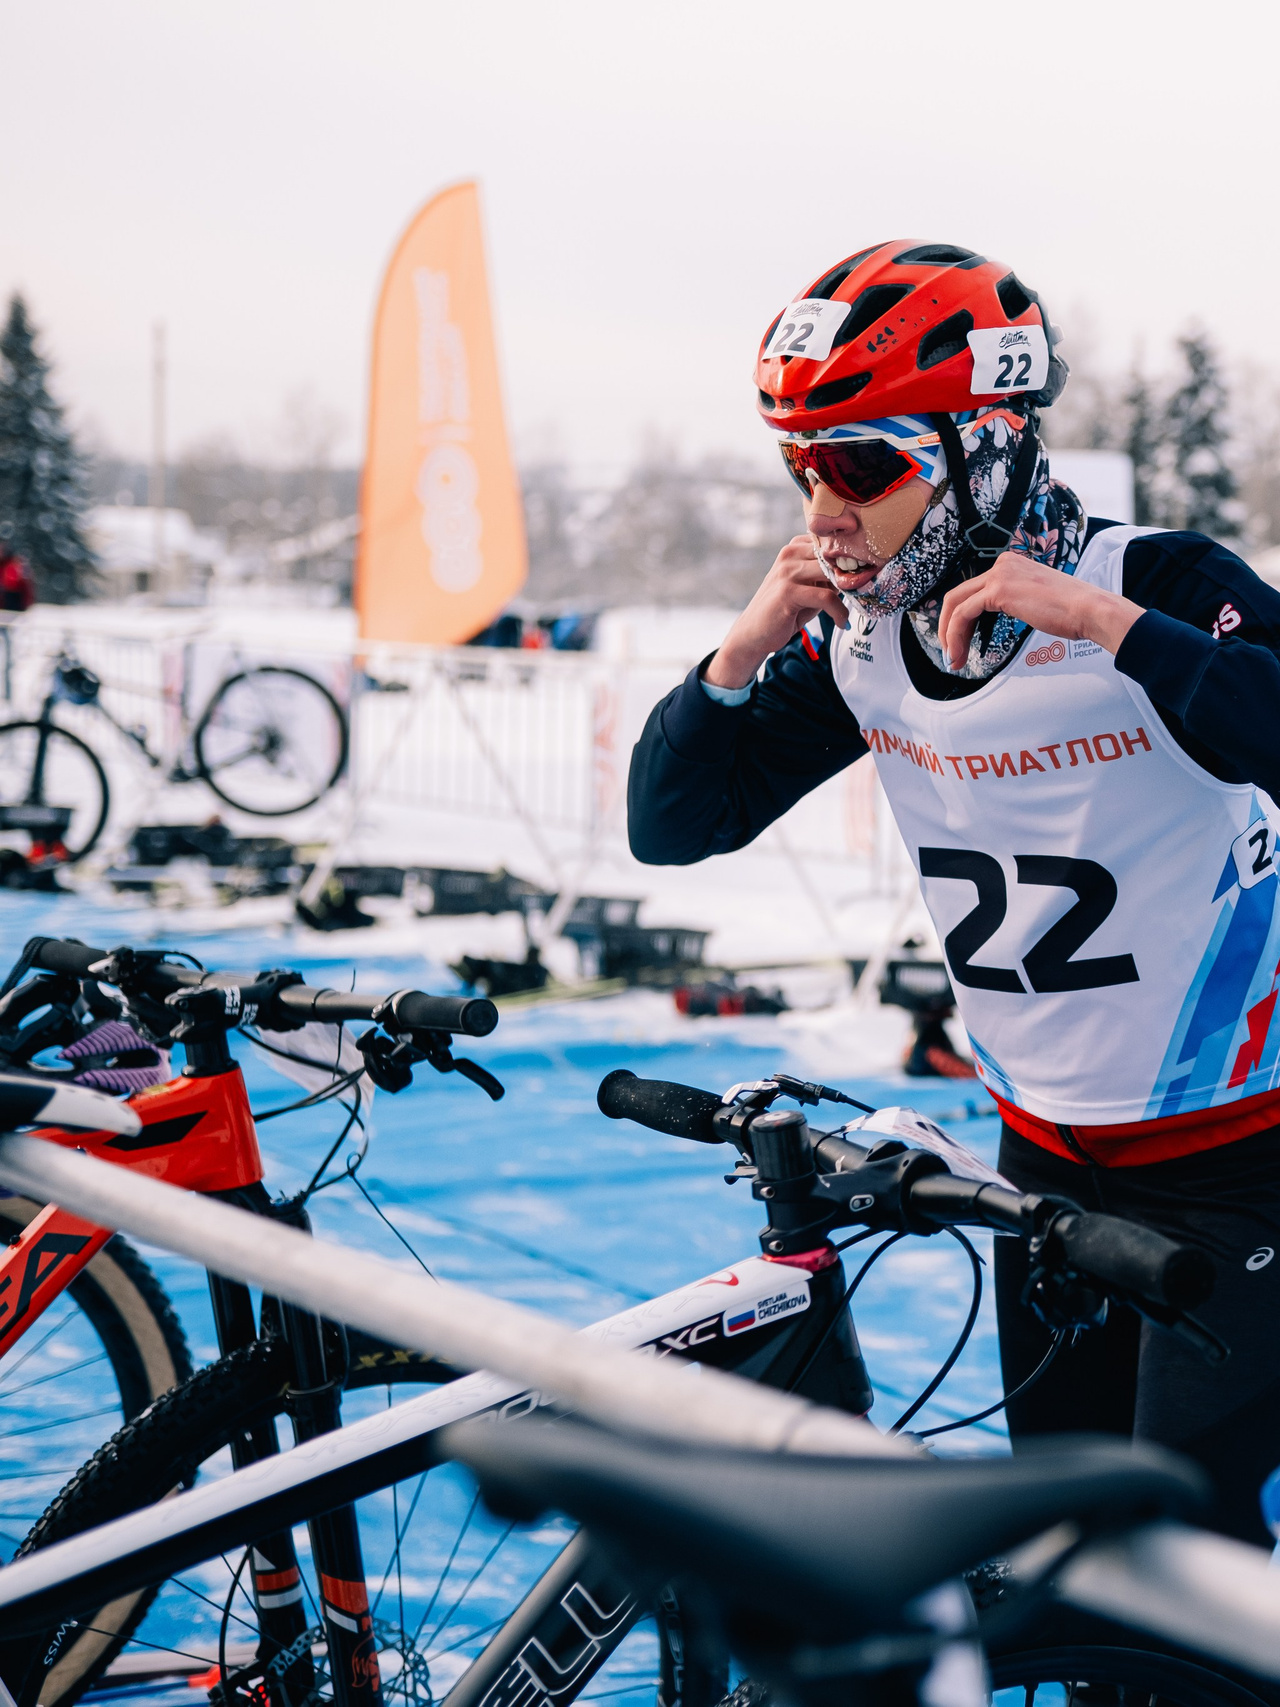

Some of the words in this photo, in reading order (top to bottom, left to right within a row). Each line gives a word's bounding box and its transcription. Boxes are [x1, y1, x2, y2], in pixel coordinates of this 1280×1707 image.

[773, 323, 814, 353] 22
[993, 353, 1032, 389] 22
[849, 647, 874, 663] Triathlon
[853, 638, 872, 652] World
[1073, 640, 1097, 651] ТРИА
[1074, 647, 1103, 658] РОССИИ
[862, 728, 945, 777] ИМНИЙ
[945, 727, 1152, 780] ТРИАТЛОН
[918, 846, 1140, 994] 22
[759, 1294, 807, 1320] CHIZHIKOVA
